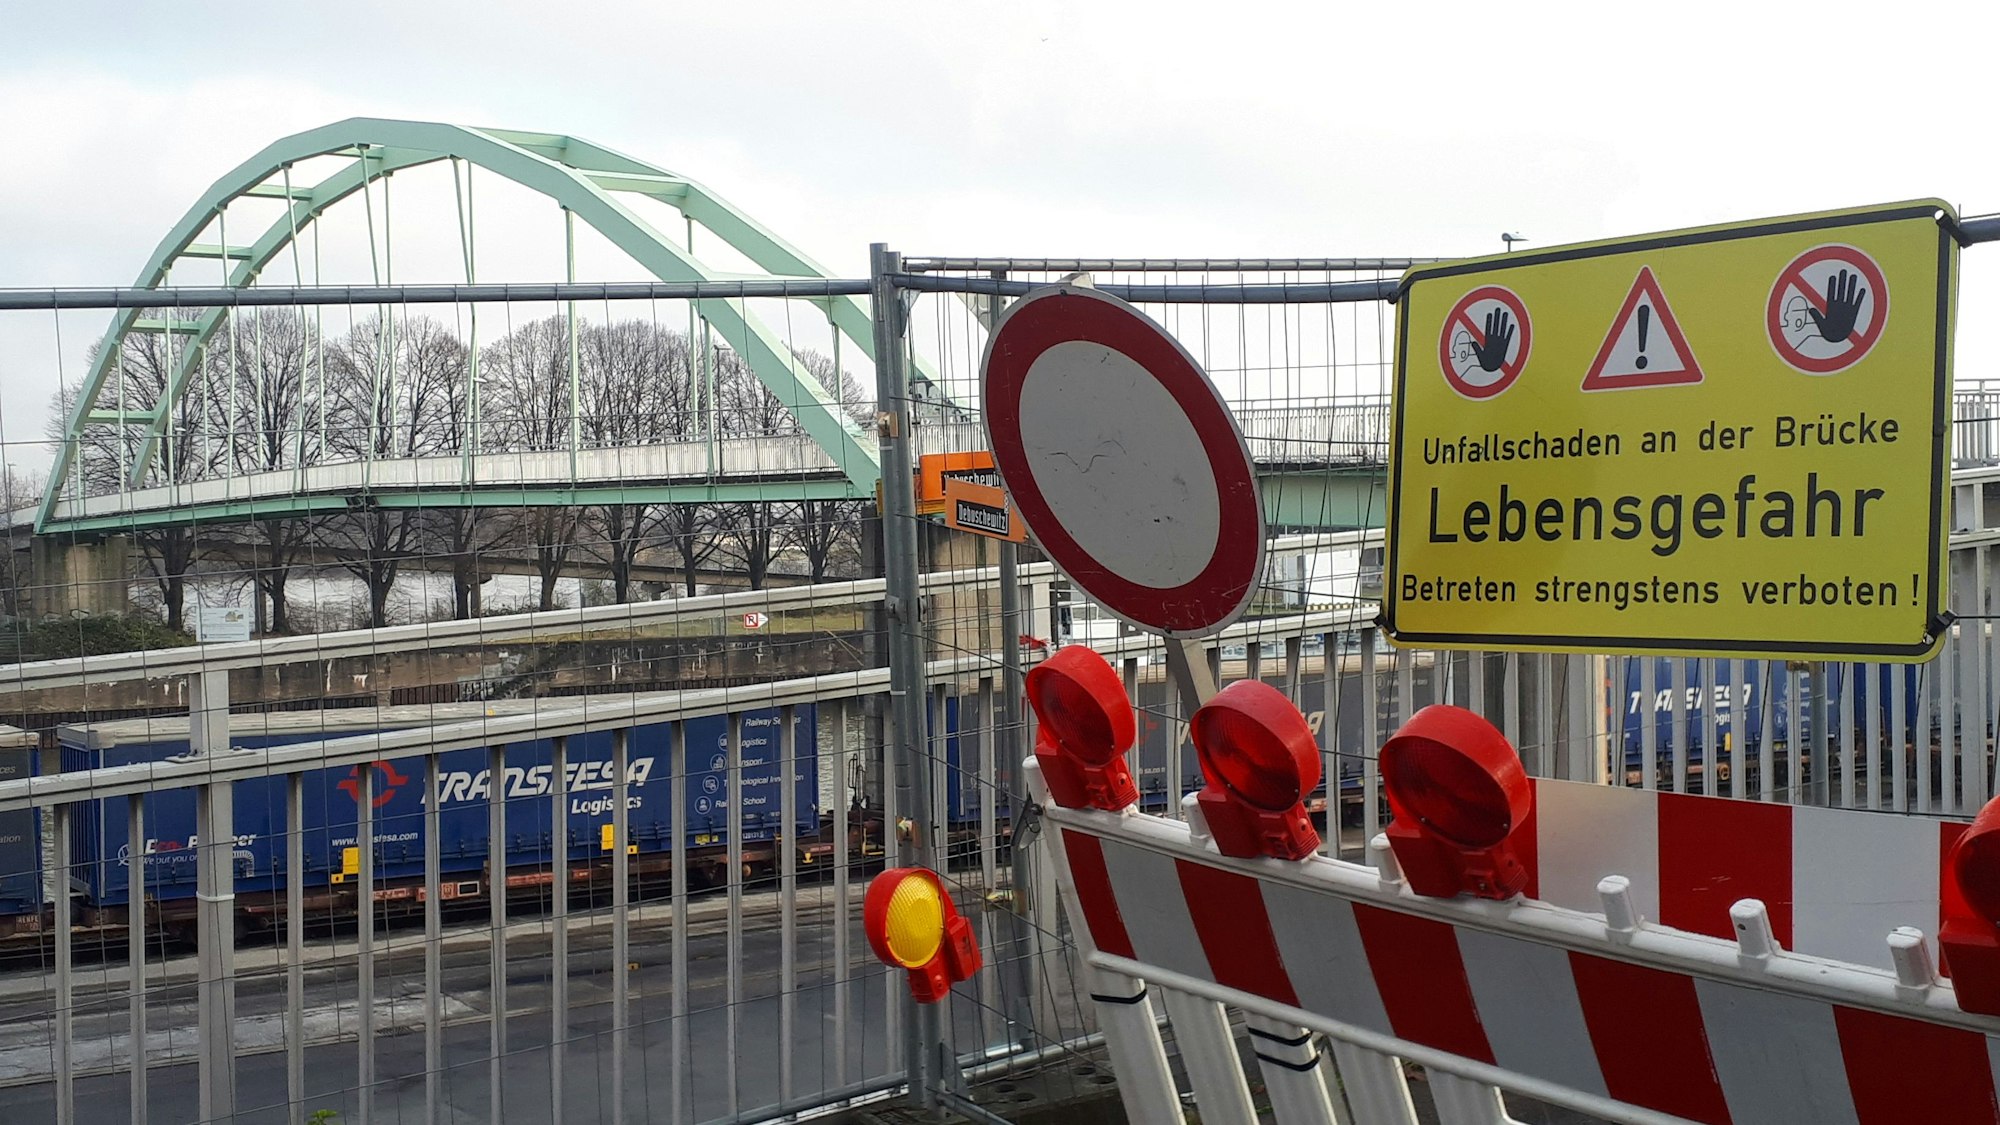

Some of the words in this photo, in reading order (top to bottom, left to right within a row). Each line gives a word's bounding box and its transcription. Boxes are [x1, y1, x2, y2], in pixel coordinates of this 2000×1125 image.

[1423, 428, 1621, 465] Unfallschaden
[1640, 430, 1677, 453] an
[1698, 420, 1755, 451] der
[1775, 412, 1900, 448] Brücke
[1428, 472, 1886, 557] Lebensgefahr
[1401, 574, 1517, 602] Betreten
[1534, 575, 1720, 611] strengstens
[745, 717, 772, 728] Railway
[741, 737, 767, 749] ogistics
[570, 794, 642, 817] Logiscs
[742, 796, 767, 806] School
[331, 831, 419, 847] www.sfesa.com
[172, 855, 187, 865] you
